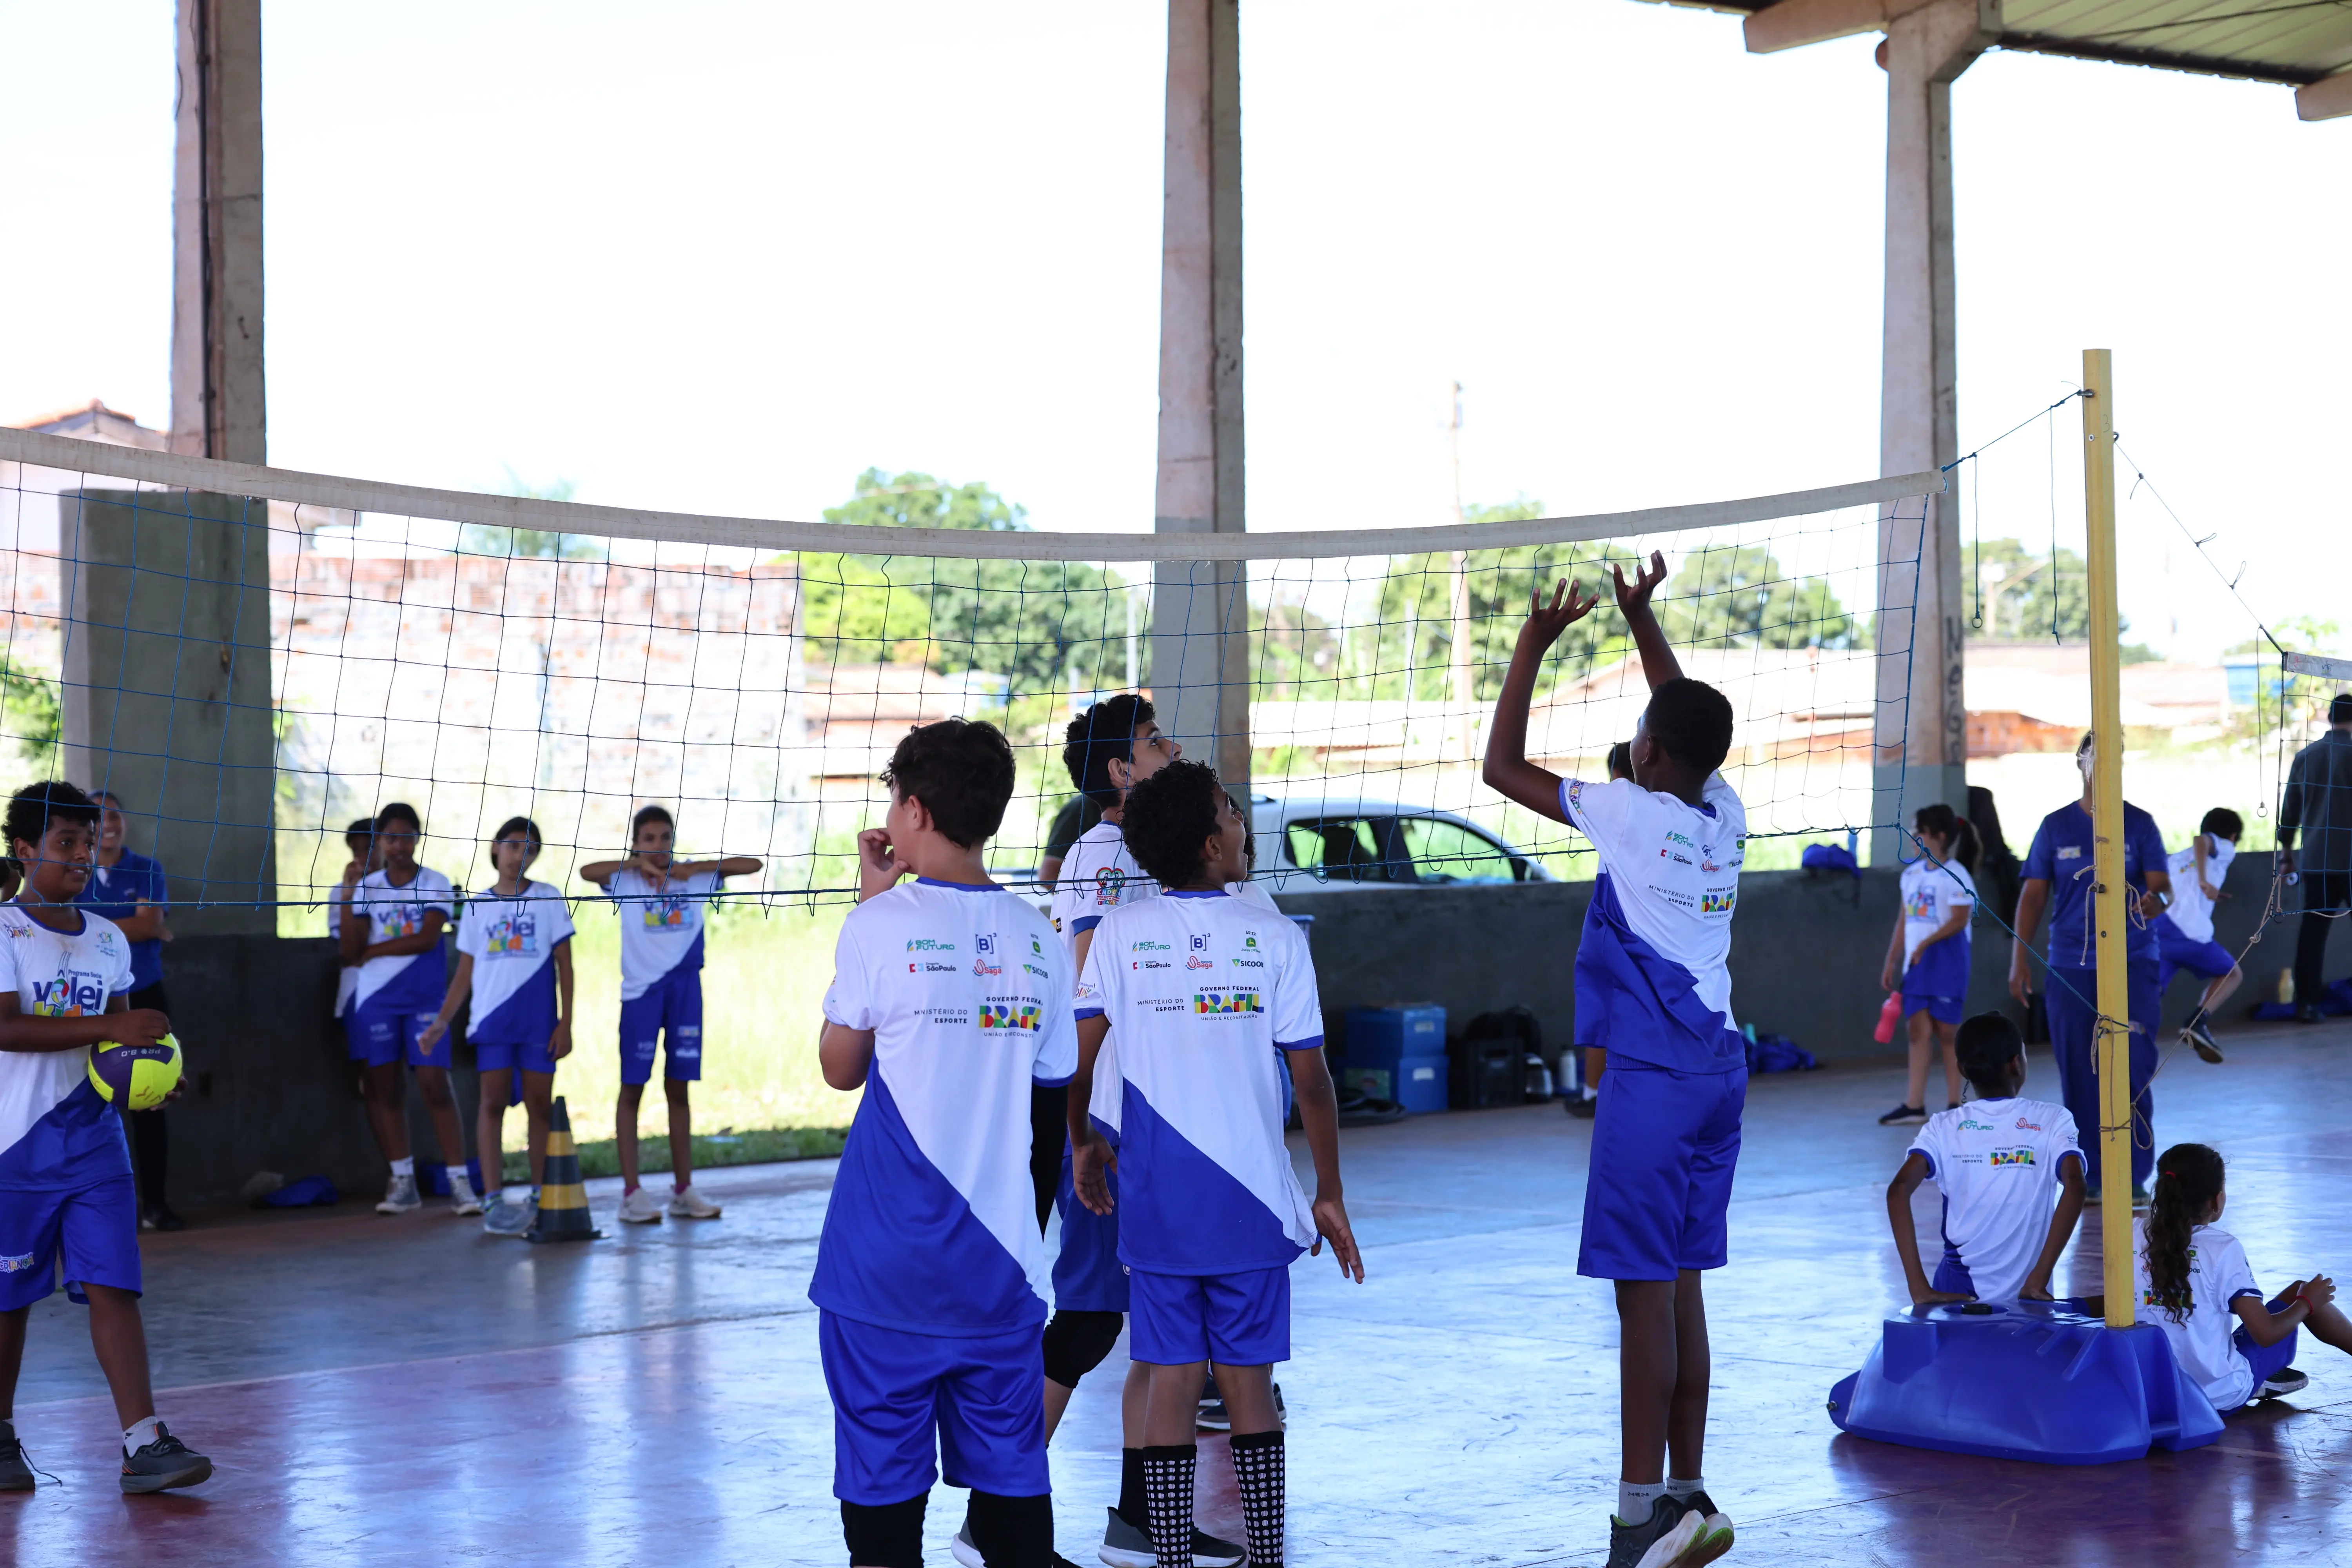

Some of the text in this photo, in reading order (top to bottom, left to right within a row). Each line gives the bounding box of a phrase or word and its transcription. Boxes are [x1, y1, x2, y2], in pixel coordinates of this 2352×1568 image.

[1673, 838, 1693, 848] FUTRO
[1648, 885, 1685, 898] MINISTÉRIO
[1668, 898, 1693, 907] ESPORTE
[68, 969, 89, 977] Programa
[984, 966, 1002, 976] Saga
[1032, 966, 1049, 979] SICOOB
[1194, 993, 1264, 1014] BRASIL
